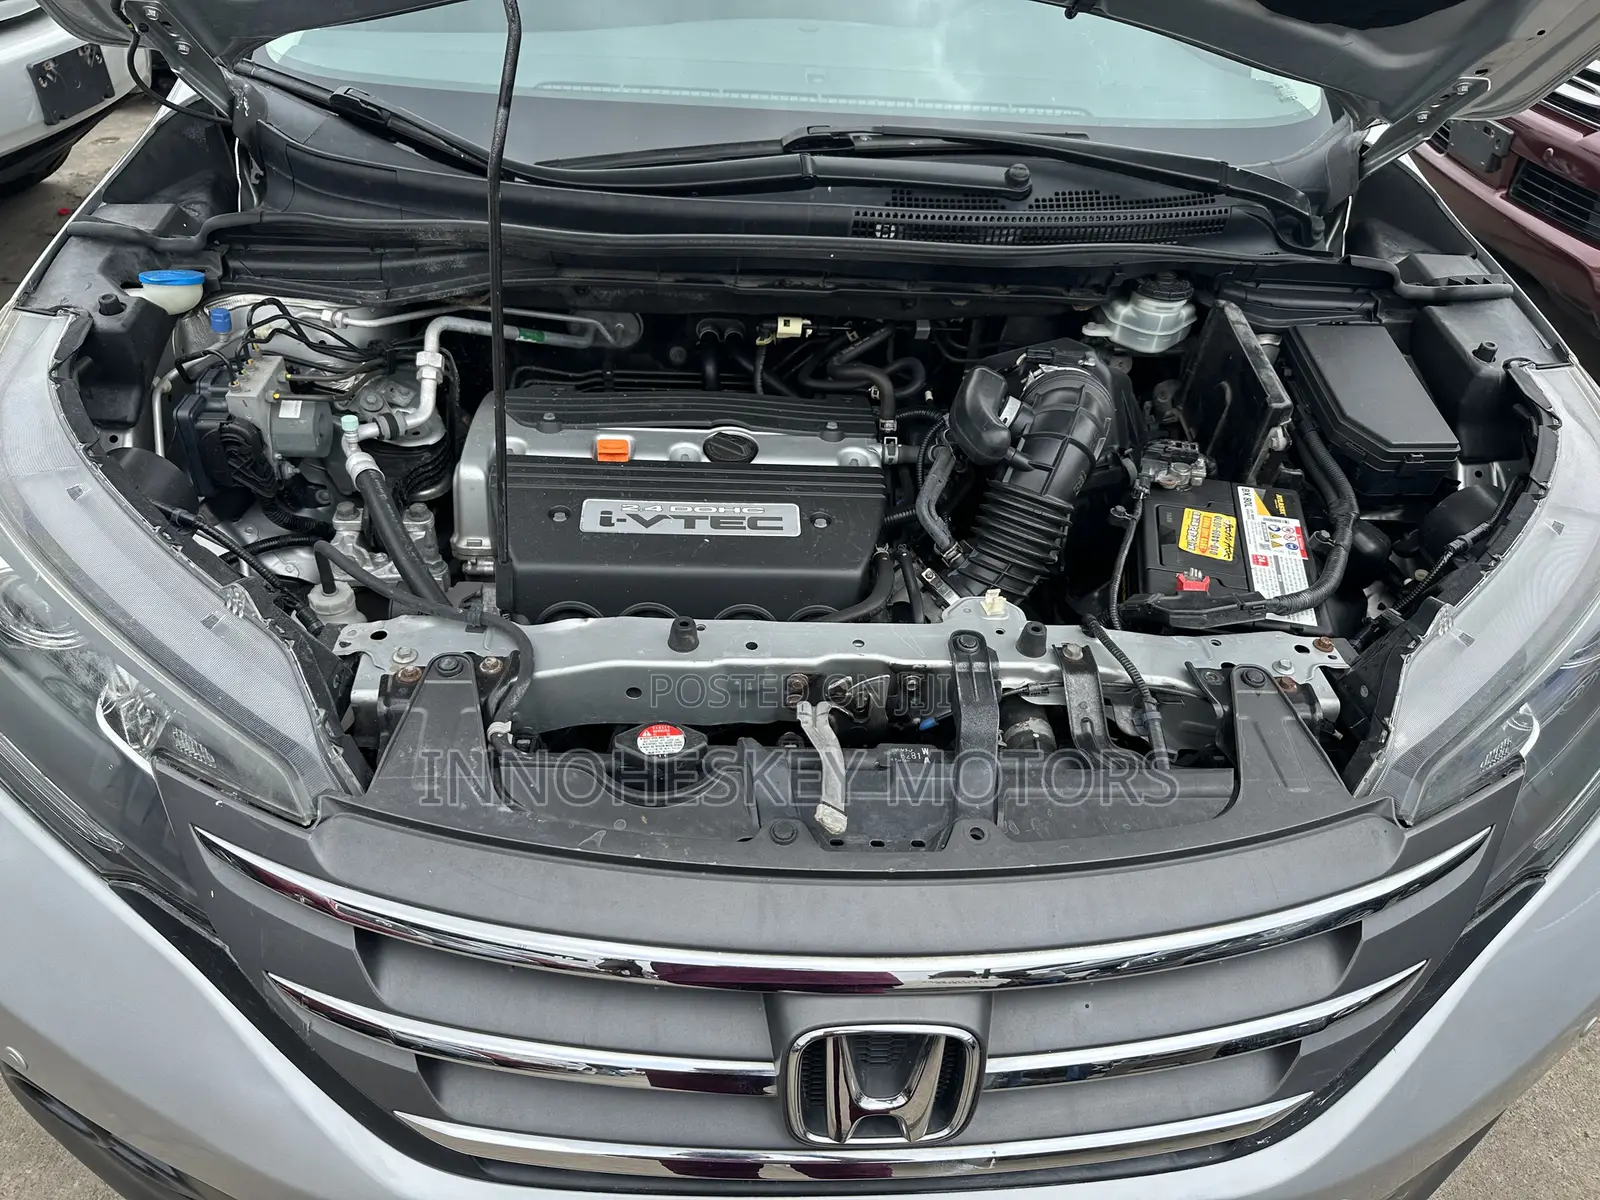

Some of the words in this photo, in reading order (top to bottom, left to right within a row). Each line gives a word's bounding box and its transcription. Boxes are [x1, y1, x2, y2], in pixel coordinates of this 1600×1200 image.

[621, 504, 663, 513] 2.4
[669, 505, 765, 514] DOHC
[599, 510, 784, 531] i-VTEC
